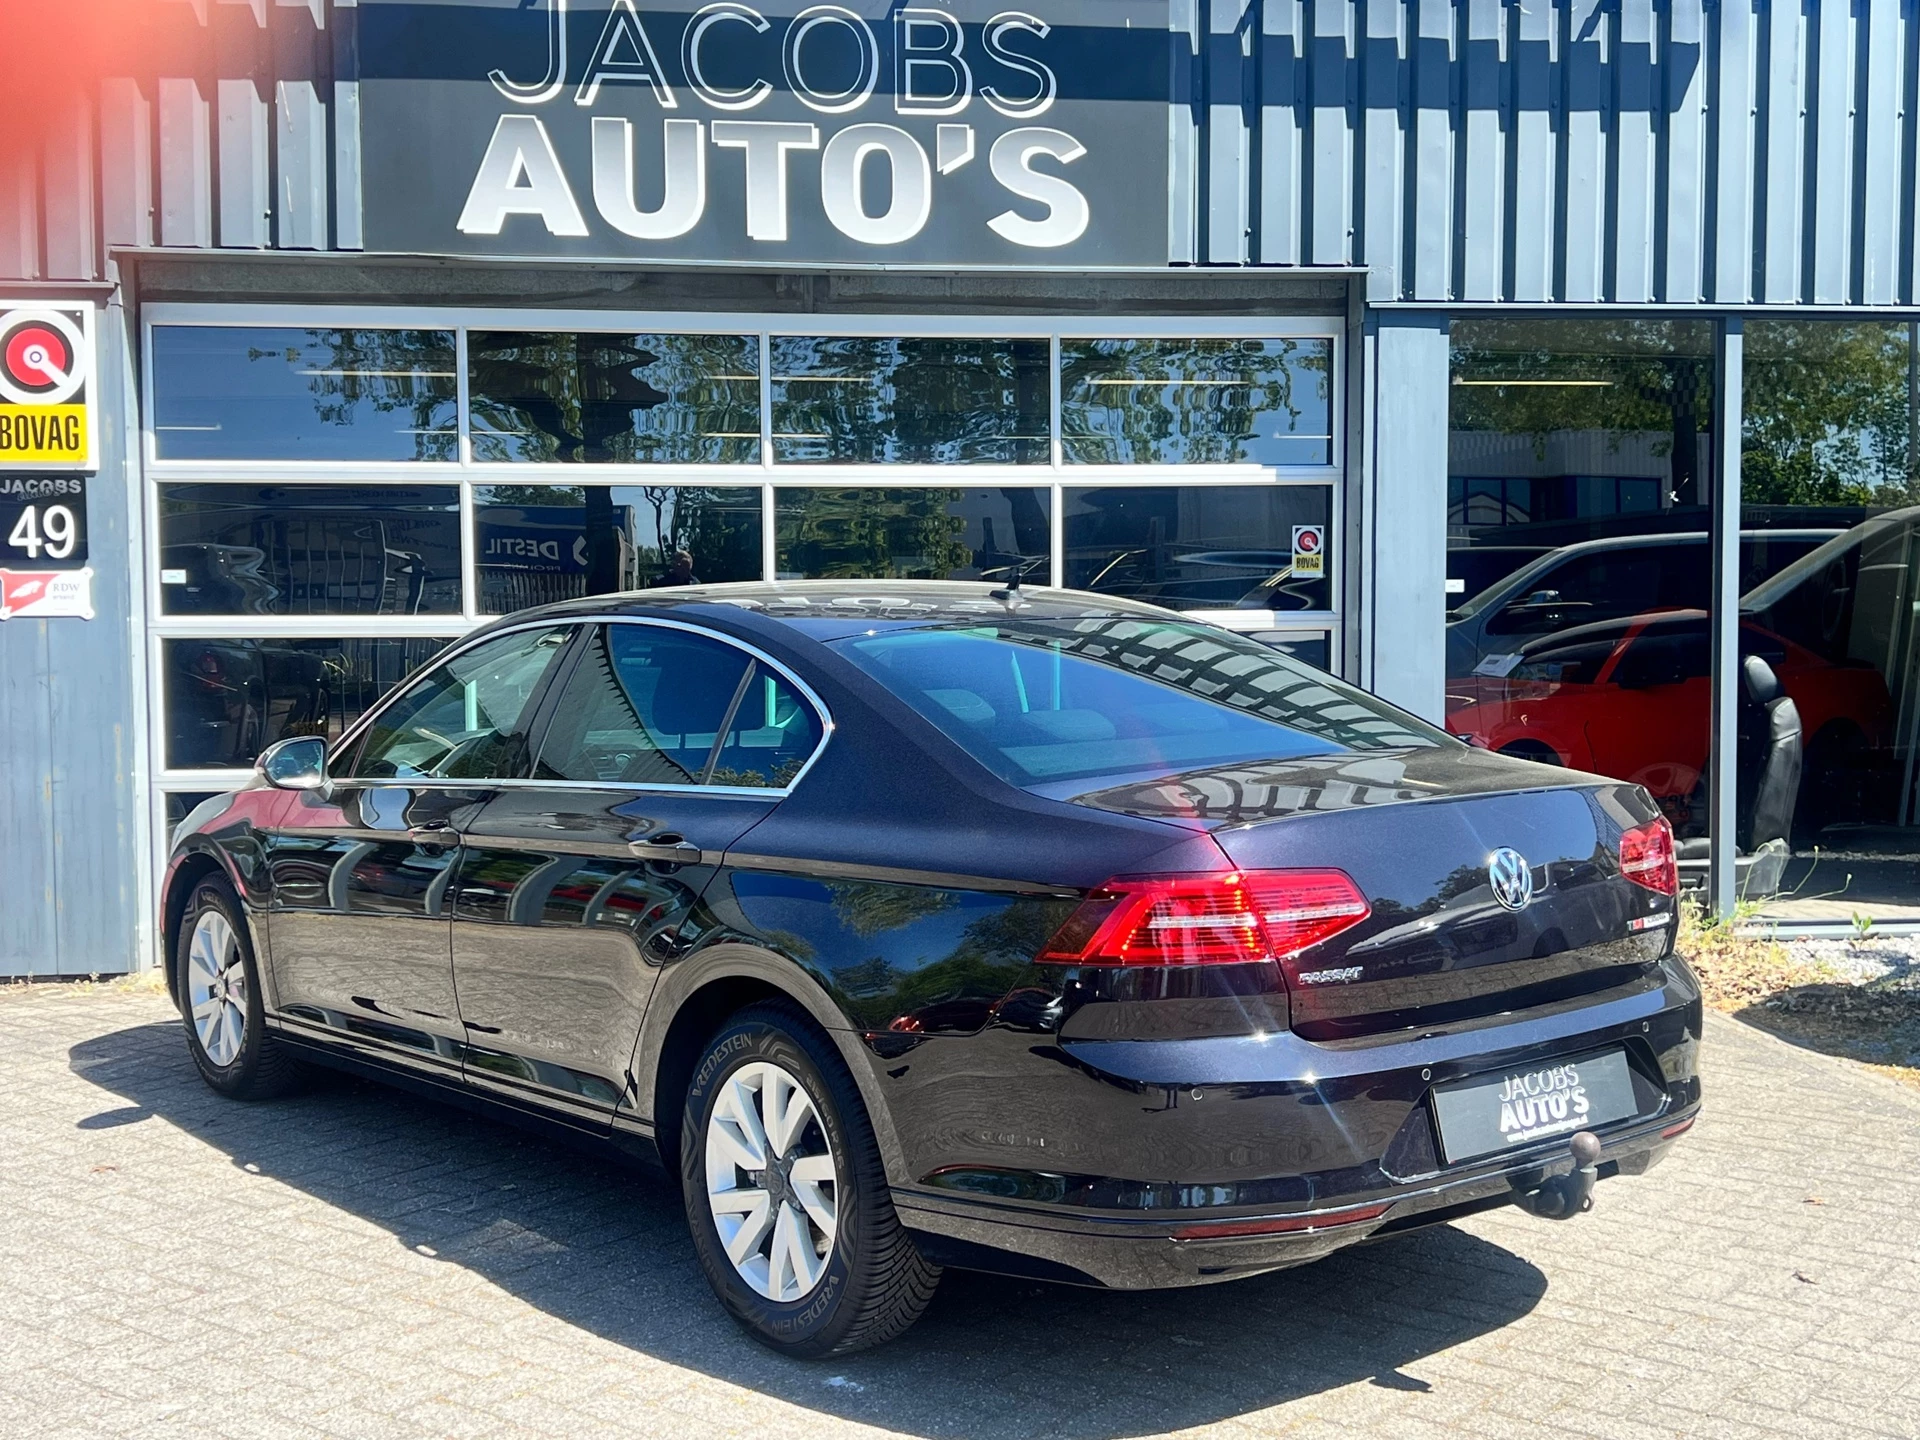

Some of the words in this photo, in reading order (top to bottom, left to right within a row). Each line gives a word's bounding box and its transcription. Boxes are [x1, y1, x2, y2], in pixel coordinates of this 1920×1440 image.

[487, 0, 1058, 118] JACOBS
[456, 114, 1091, 248] AUTO'S
[0, 414, 80, 451] BOVAG
[0, 479, 82, 494] JACOBS
[8, 505, 76, 559] 49
[1296, 557, 1319, 569] BOVAG
[52, 583, 80, 592] RDW
[692, 1032, 753, 1097] VREDESTEIN
[1499, 1064, 1579, 1102] JACOBS
[1500, 1086, 1590, 1133] AUTO'S
[771, 1275, 839, 1334] VREDESTEIN
